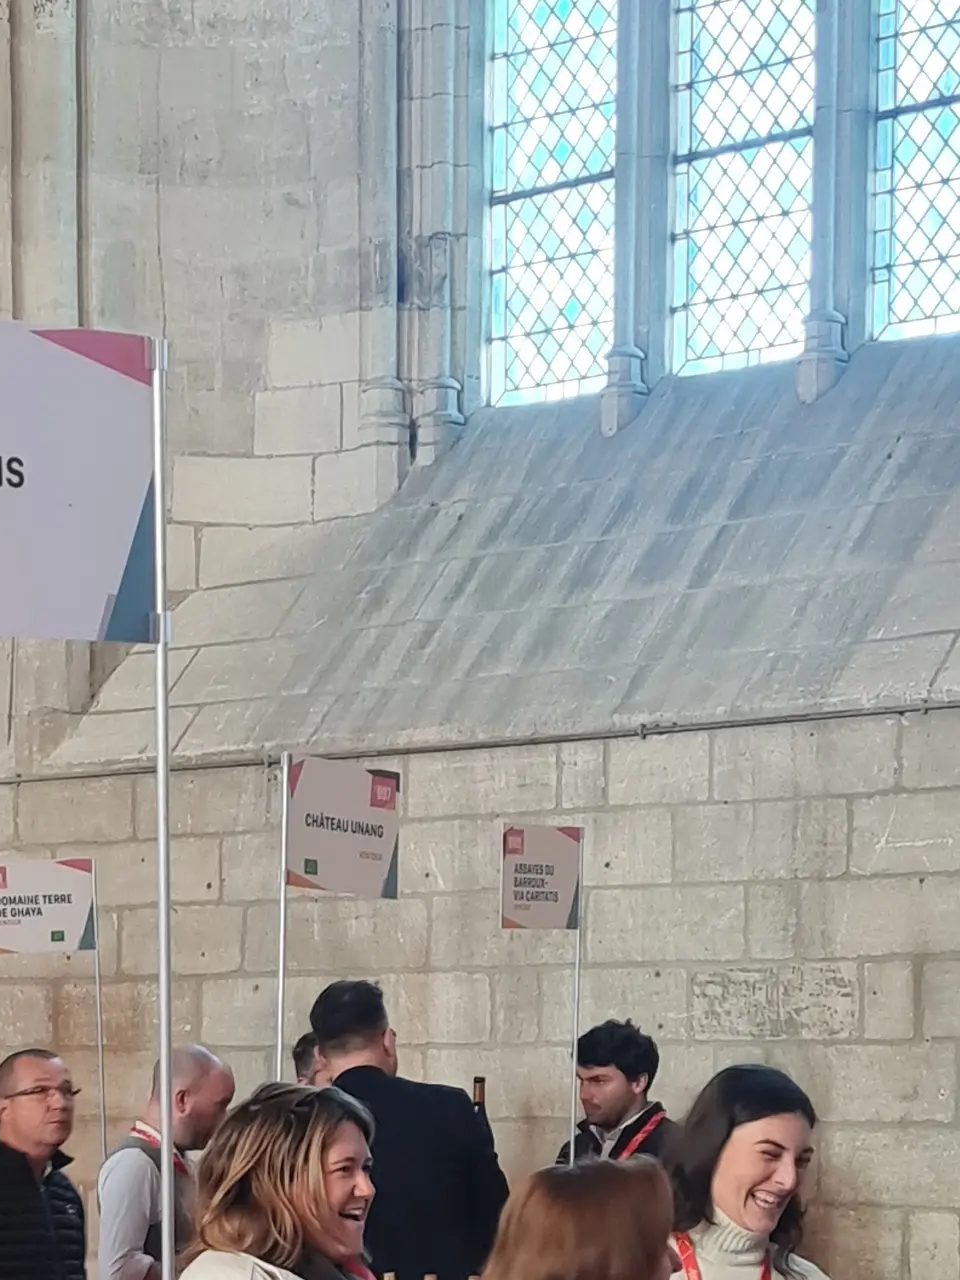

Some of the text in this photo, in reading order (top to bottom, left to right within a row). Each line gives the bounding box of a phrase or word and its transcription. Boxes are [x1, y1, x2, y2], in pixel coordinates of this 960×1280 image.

[305, 812, 384, 838] CHÂTEAU UNANG
[41, 894, 73, 905] TERRE
